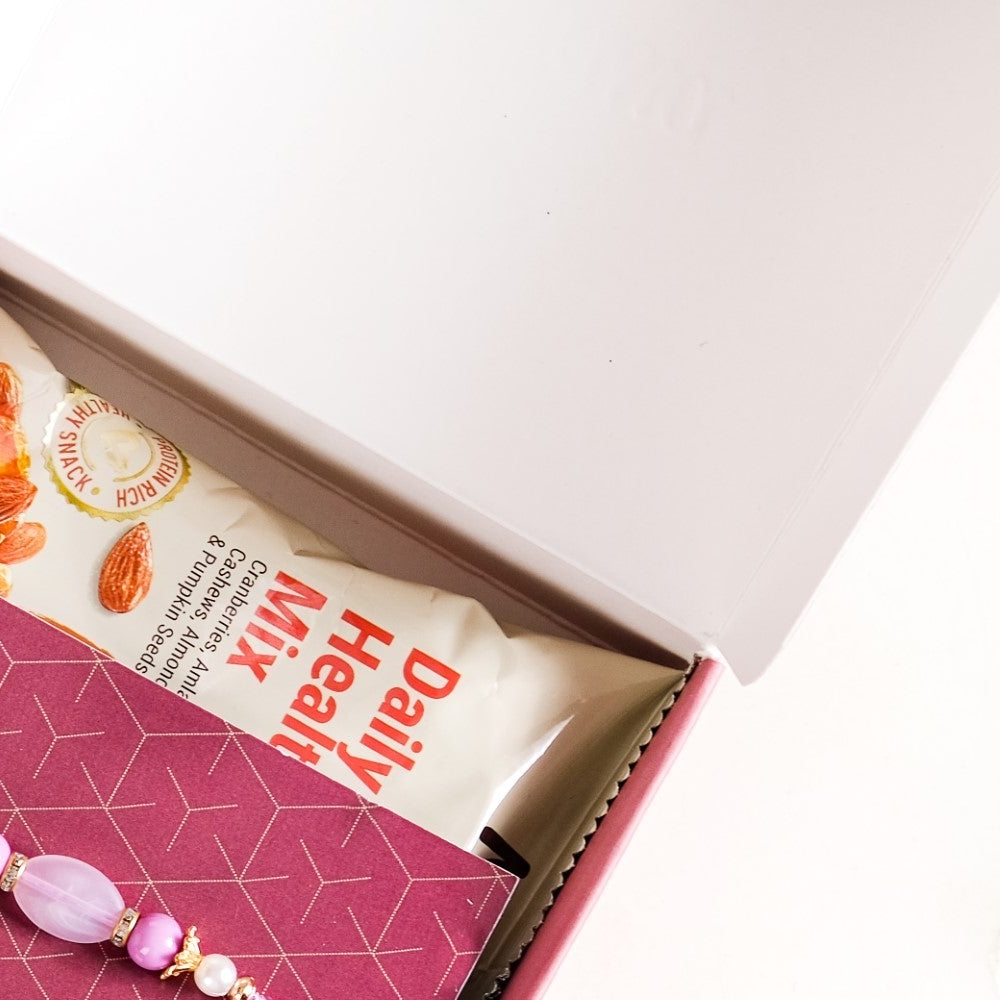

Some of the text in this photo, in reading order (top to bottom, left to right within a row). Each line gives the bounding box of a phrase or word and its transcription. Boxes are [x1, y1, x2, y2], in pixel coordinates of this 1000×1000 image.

[58, 431, 92, 492] SNACK
[116, 436, 179, 507] PROTEIN RICH
[135, 535, 226, 674] & Pumpkin Seeds
[189, 548, 246, 620] Cashews,
[199, 560, 267, 653] Cranberries,
[226, 570, 328, 683] Mix
[269, 609, 395, 765] Healt
[336, 647, 461, 795] Daily
